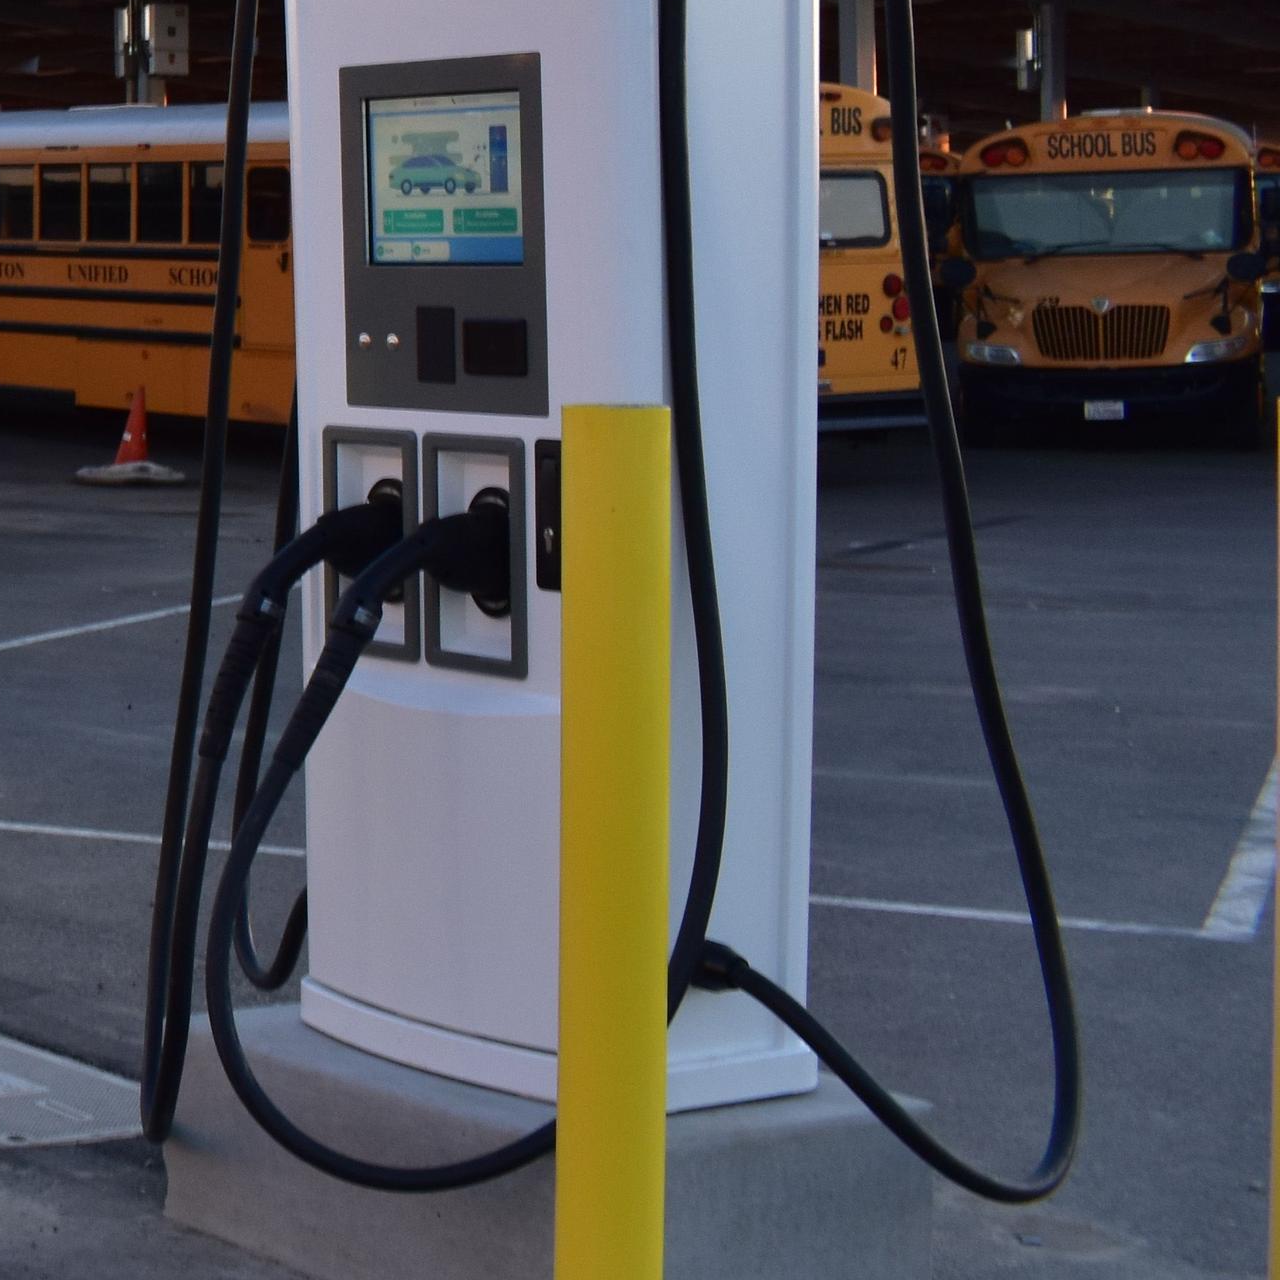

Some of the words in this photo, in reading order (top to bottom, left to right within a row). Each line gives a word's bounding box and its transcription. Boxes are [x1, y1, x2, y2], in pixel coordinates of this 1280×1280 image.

[831, 107, 862, 136] BUS
[1047, 133, 1117, 160] SCHOOL
[1122, 131, 1156, 157] BUS
[67, 263, 129, 284] UNIFIED
[169, 267, 219, 288] SCHO
[819, 294, 842, 316] HEN
[846, 293, 870, 315] RED
[825, 319, 863, 341] FLASH
